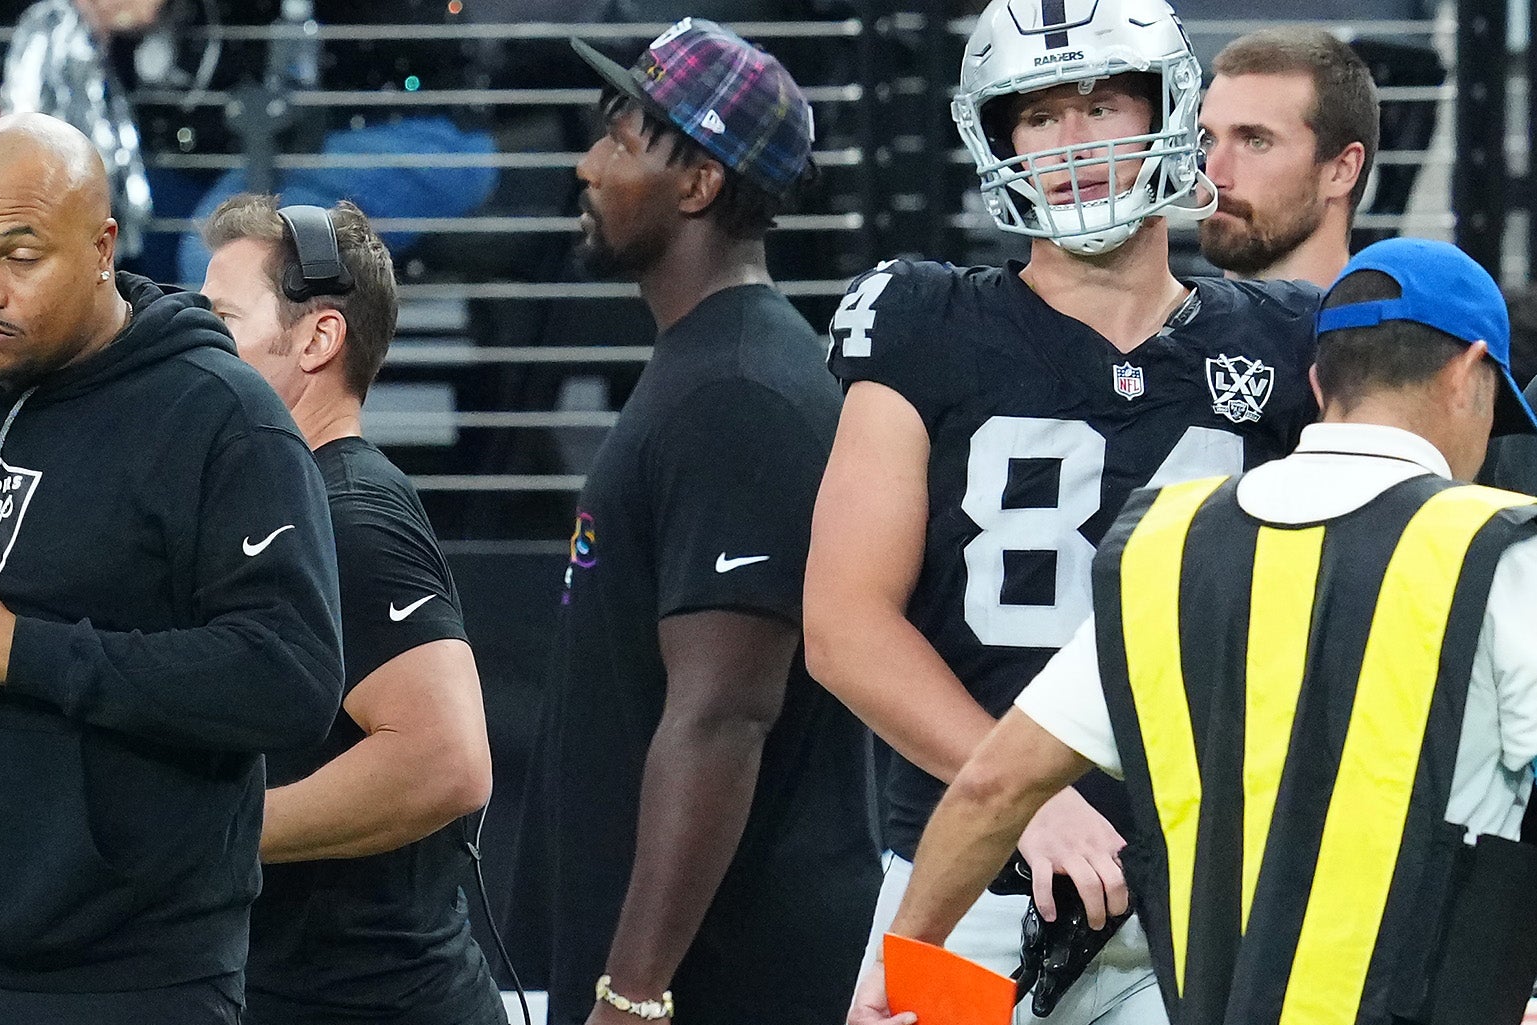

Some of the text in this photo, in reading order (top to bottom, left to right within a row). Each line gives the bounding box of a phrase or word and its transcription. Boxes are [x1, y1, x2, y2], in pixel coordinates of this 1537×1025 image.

[825, 273, 893, 362] 4
[1119, 378, 1140, 392] NFL
[1215, 371, 1269, 397] LXV
